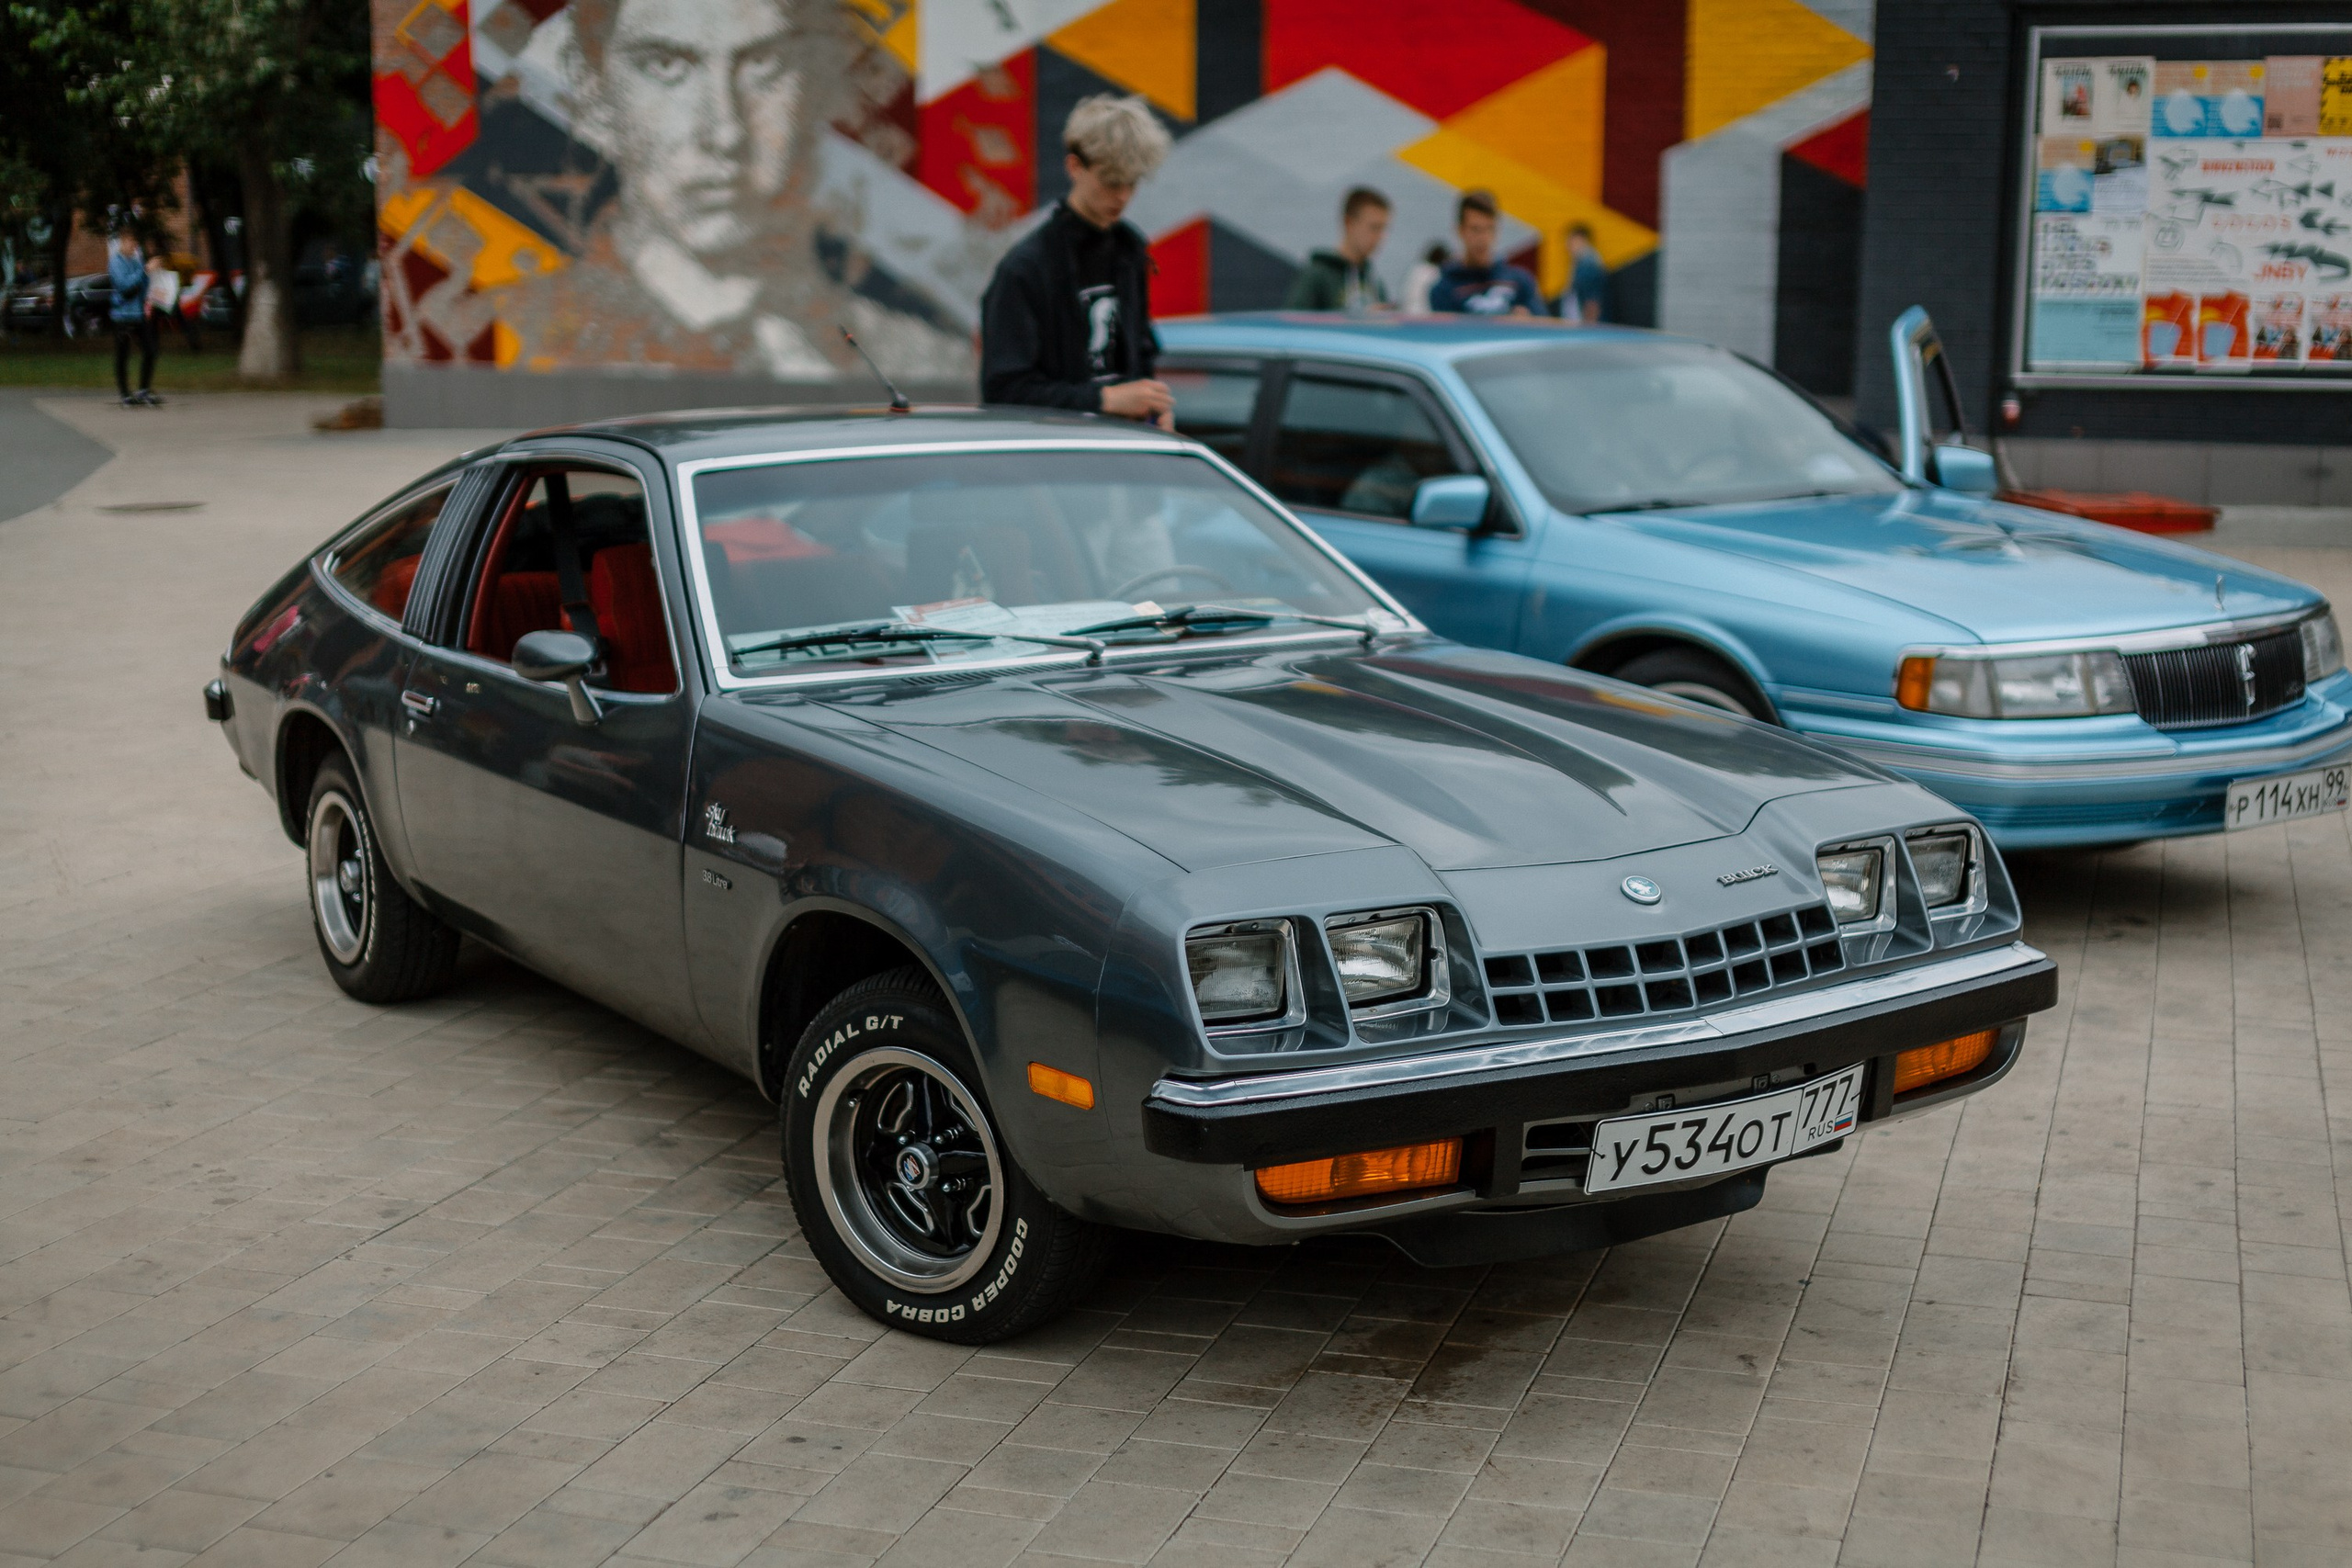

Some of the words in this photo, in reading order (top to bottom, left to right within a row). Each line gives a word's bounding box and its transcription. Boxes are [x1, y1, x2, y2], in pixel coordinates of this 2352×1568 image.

[1717, 863, 1779, 886] BUICK
[797, 1022, 860, 1099] RADIAL
[865, 1015, 904, 1031] G/T
[1802, 1074, 1855, 1129] 777
[1807, 1120, 1835, 1142] RUS
[973, 1216, 1029, 1312] COOPER
[886, 1298, 967, 1324] COBRA
